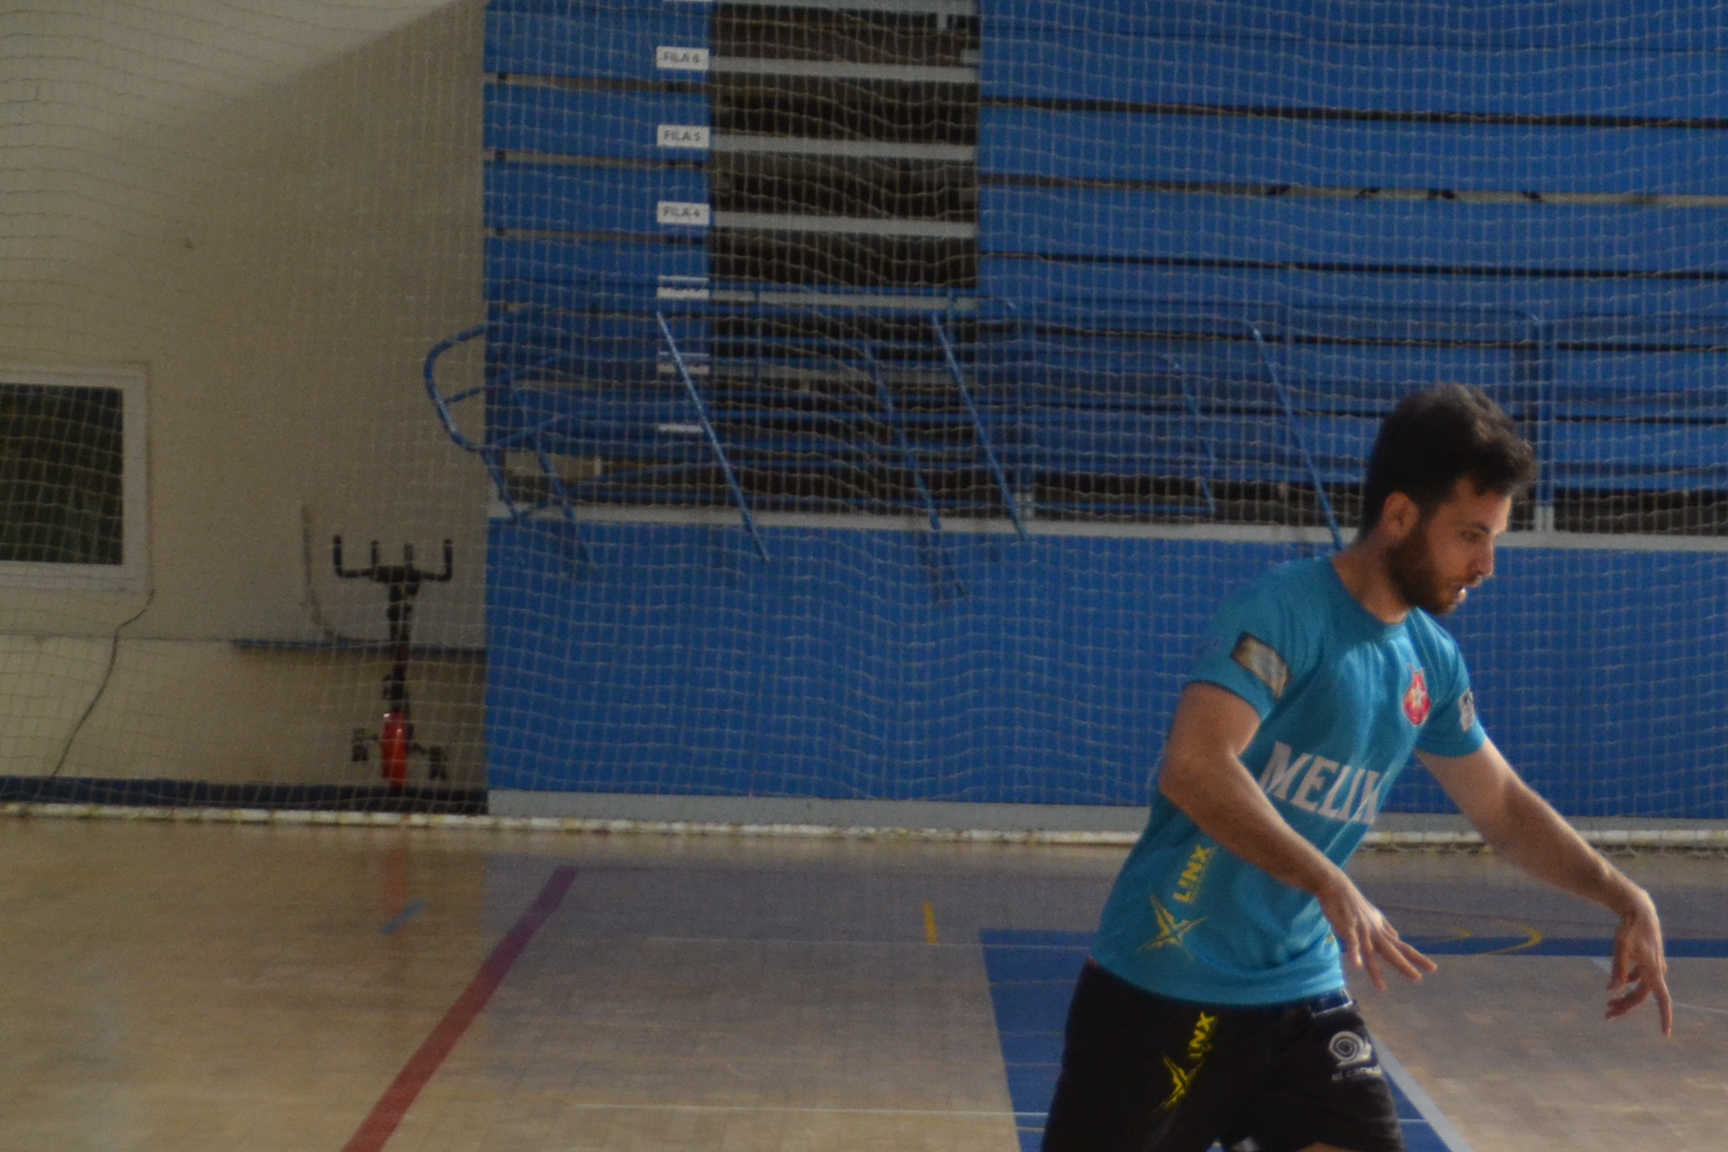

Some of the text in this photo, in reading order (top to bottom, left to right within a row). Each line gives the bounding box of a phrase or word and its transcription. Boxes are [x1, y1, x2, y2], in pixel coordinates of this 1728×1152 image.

[663, 51, 690, 63] FILA
[663, 129, 691, 141] FILA
[663, 205, 690, 217] FILA
[1172, 844, 1213, 904] LINX
